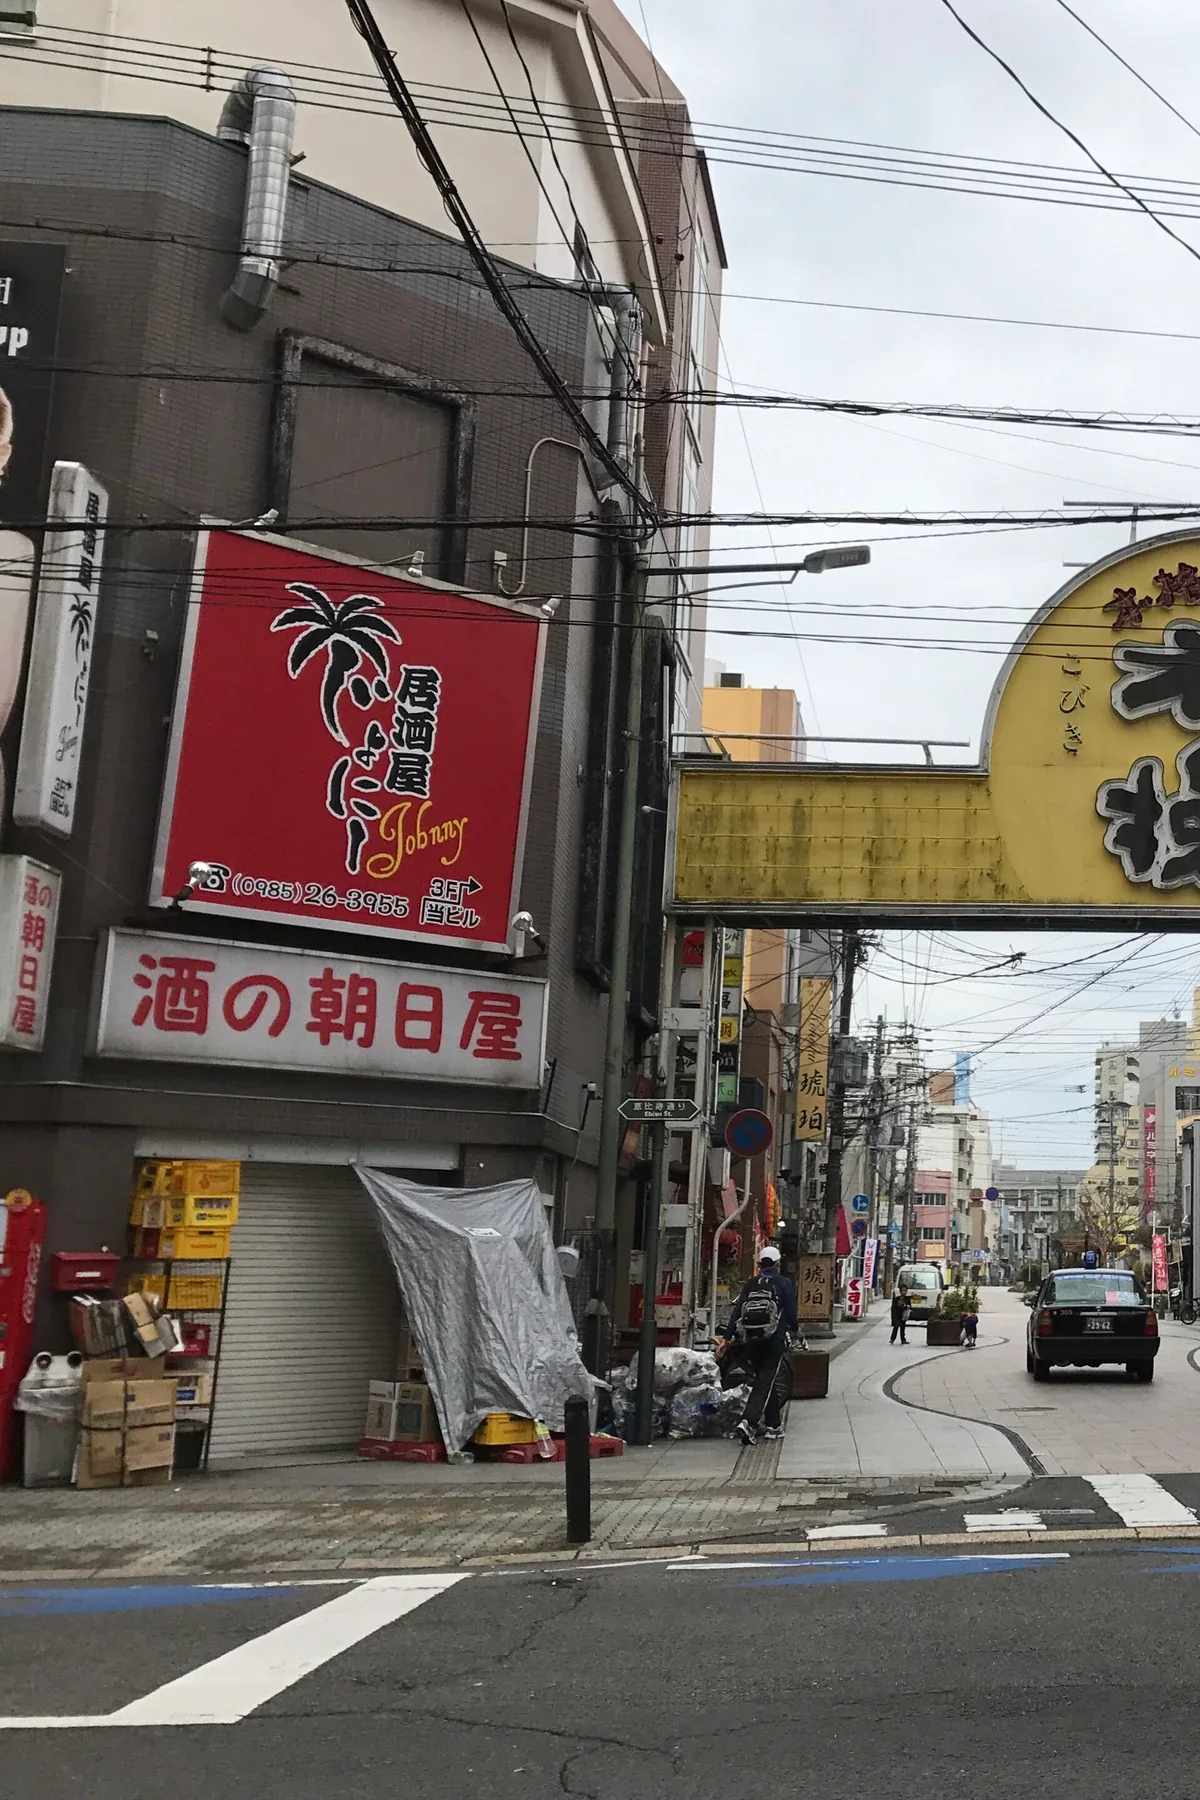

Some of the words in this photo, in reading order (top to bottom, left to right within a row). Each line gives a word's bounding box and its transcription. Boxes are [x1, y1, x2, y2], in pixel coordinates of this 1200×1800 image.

[384, 664, 442, 798] 居酒屋
[1059, 652, 1091, 756] こびき
[366, 800, 468, 878] Johnny
[425, 902, 480, 928] 当ビル
[131, 953, 523, 1061] 酒の朝日屋
[799, 1069, 826, 1131] 琥珀
[804, 1265, 826, 1305] 琥珀
[847, 1279, 862, 1317] くすり
